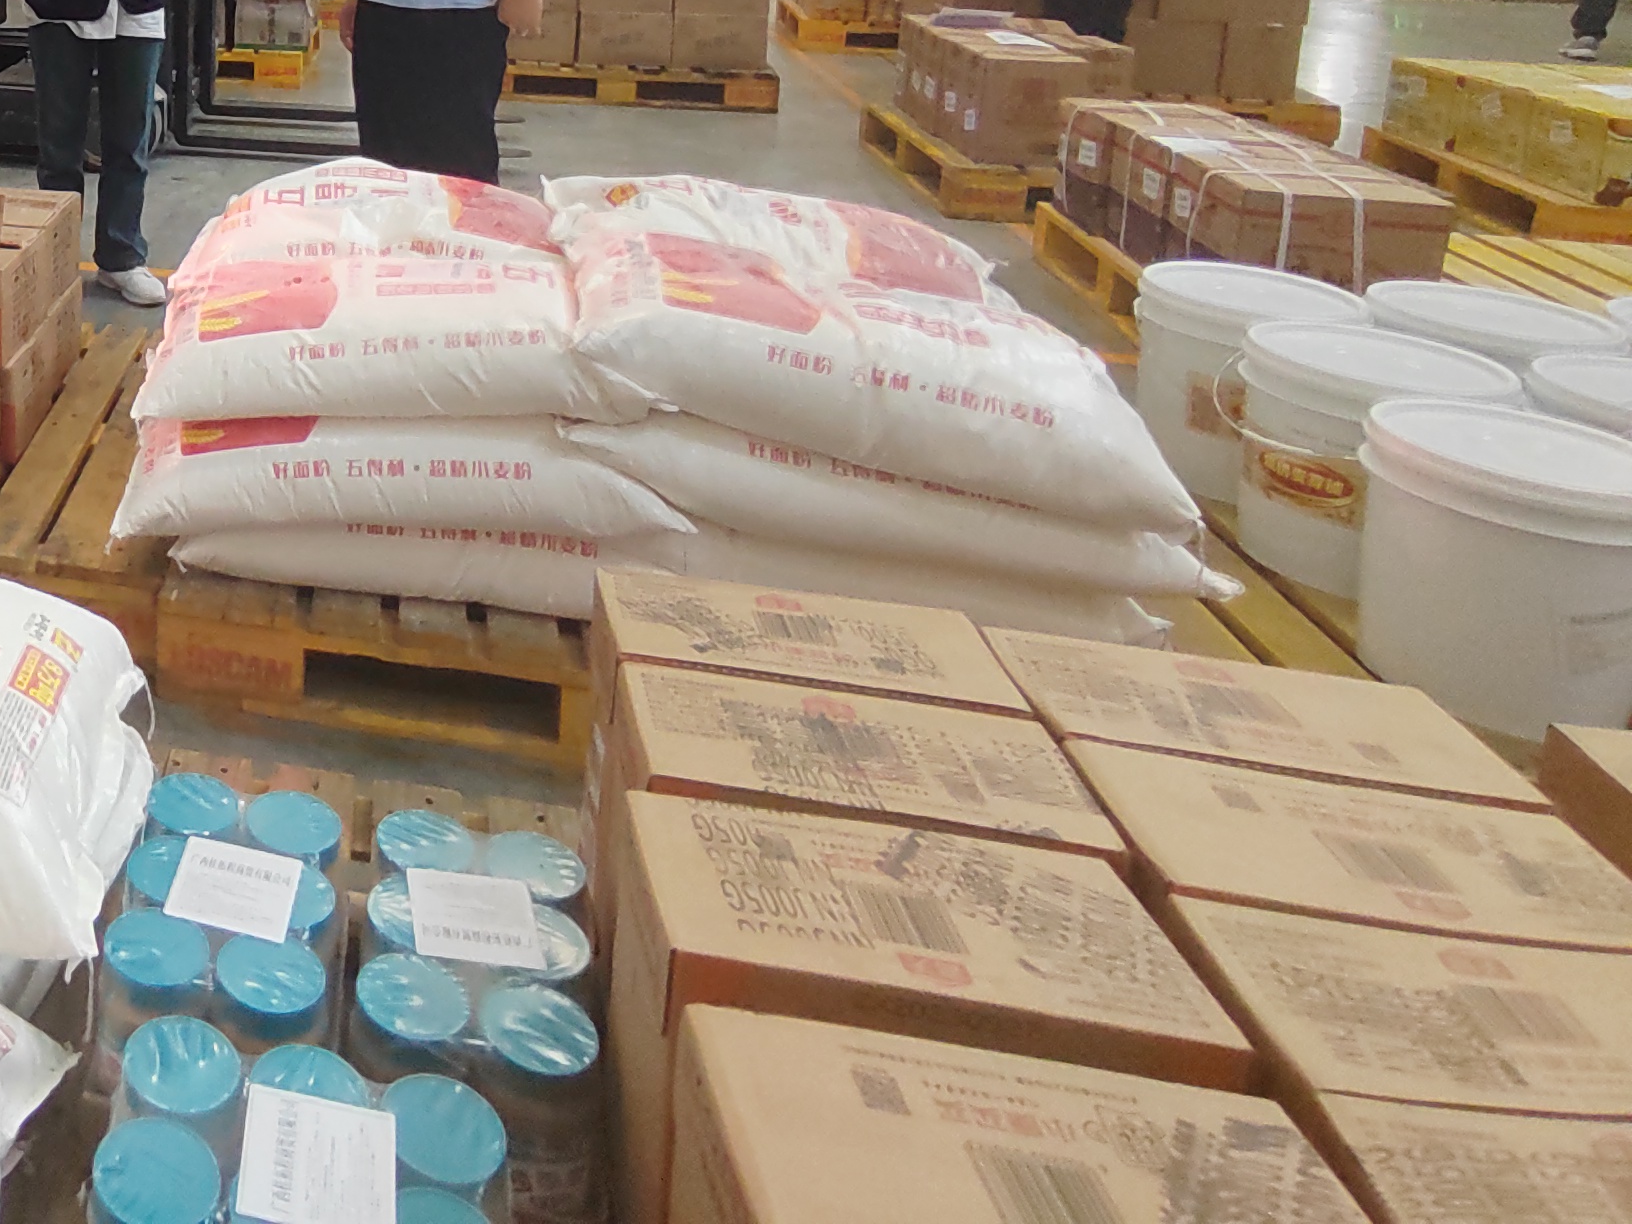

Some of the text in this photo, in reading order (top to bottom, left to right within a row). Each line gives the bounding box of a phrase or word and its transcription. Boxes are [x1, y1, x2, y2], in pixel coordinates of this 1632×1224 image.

[288, 341, 346, 362] 好面粉
[767, 344, 833, 376] 好面粉
[272, 460, 331, 480] 好面粉
